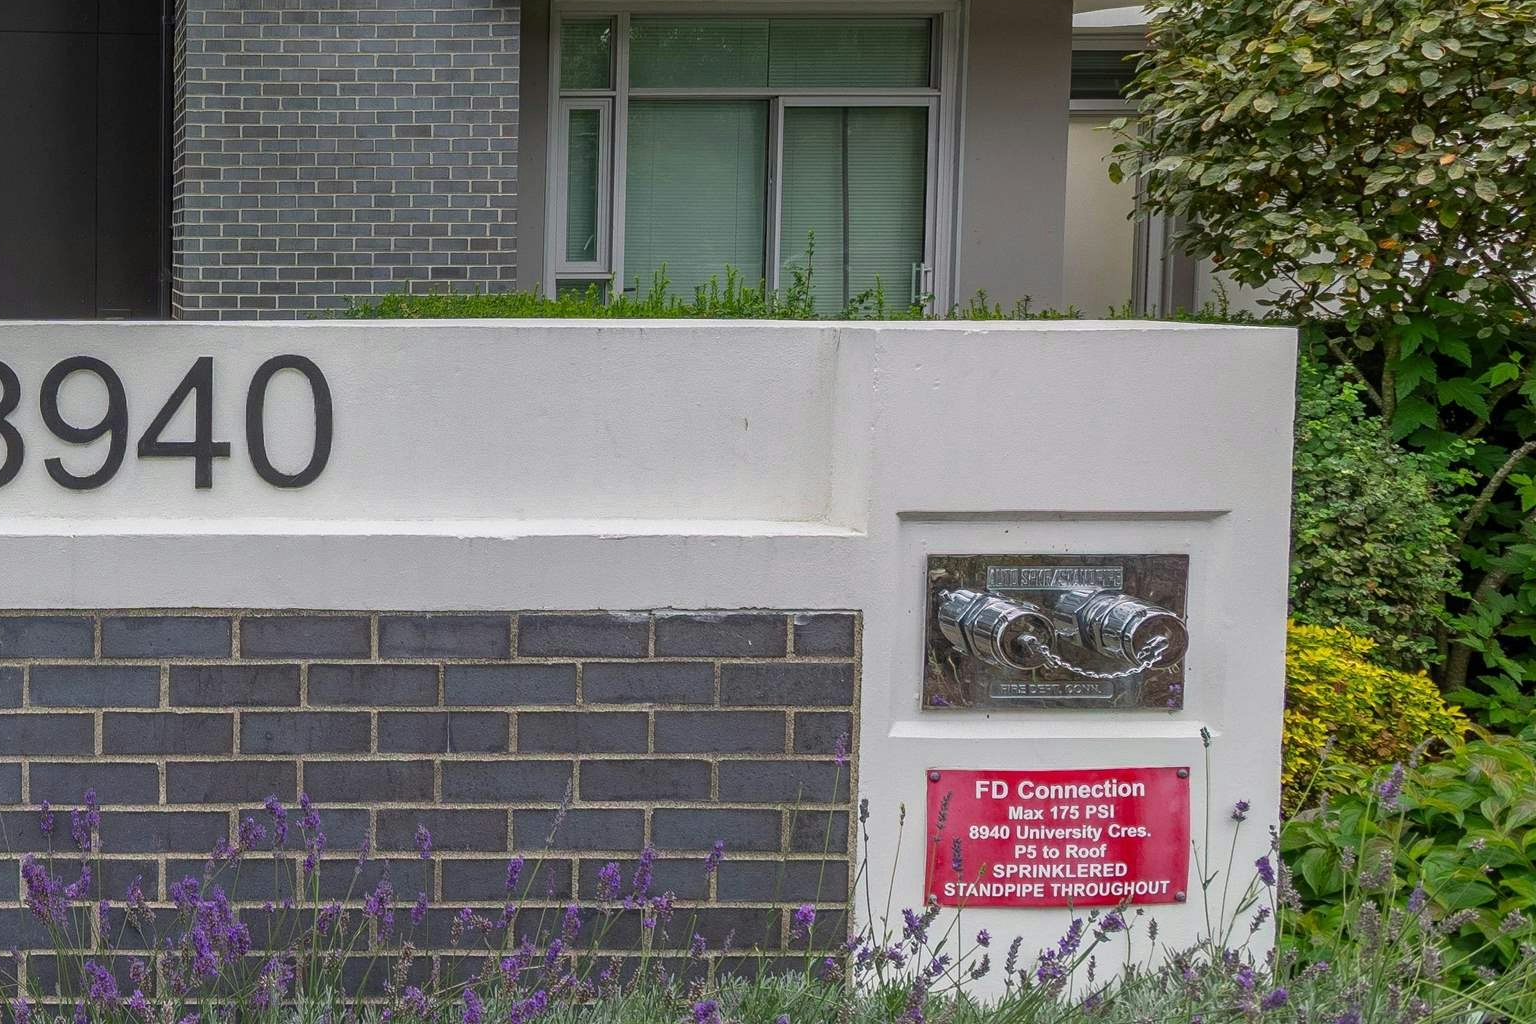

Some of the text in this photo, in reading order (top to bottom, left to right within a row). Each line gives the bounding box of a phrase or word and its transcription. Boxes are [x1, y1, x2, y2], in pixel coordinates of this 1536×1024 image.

[1000, 683, 1026, 694] FIRE
[975, 779, 1145, 800] FD Connection
[1008, 805, 1115, 820] Max 175 PSI
[969, 824, 1152, 842] 8940 University Cres.
[1014, 844, 1107, 859] P5 to Roof
[993, 863, 1128, 878] SPRINKLERED
[944, 880, 1170, 897] STANDPIPE THROUGHOUT
